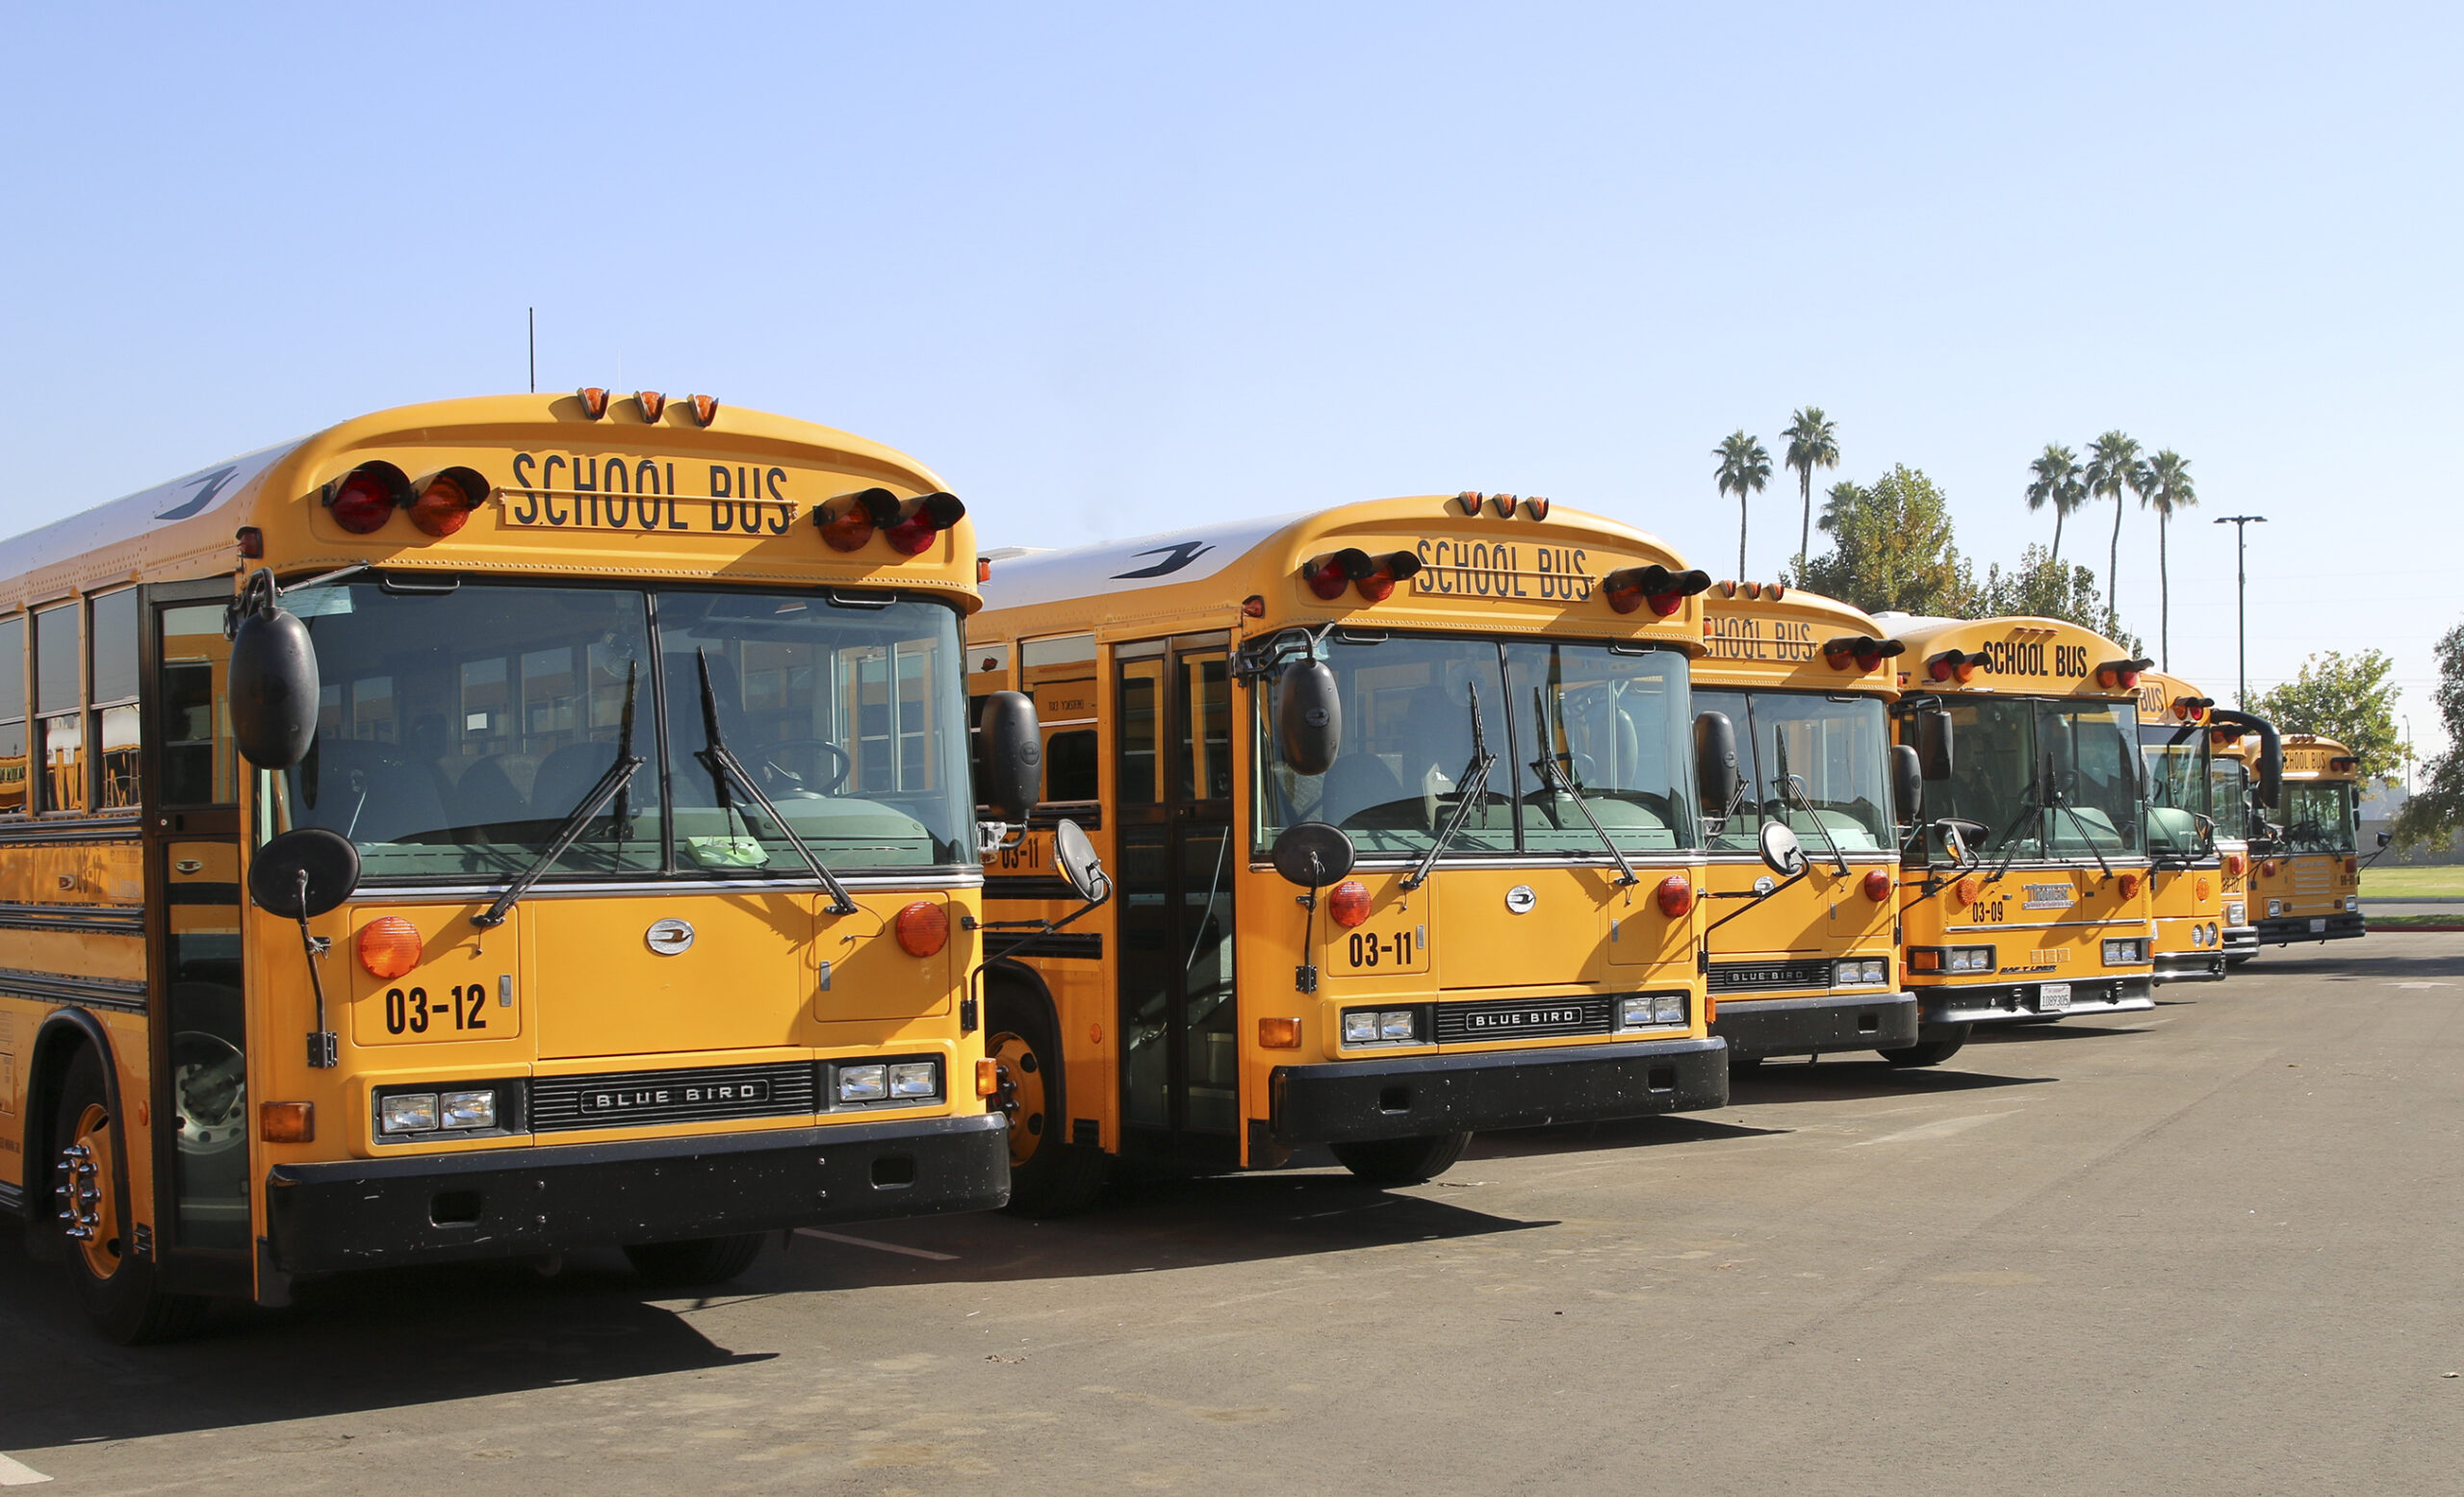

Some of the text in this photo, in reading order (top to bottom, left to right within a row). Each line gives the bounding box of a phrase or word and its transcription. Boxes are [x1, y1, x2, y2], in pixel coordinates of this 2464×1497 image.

[512, 452, 790, 535] SCHOOL BUS
[1417, 539, 1591, 601] SCHOOL BUS
[1775, 622, 1812, 661] BUS
[1983, 640, 2088, 679] SCHOOL BUS
[2311, 751, 2326, 769] BUS
[1972, 901, 2003, 922] 03-09
[1349, 932, 1411, 968] 03-11
[1732, 970, 1803, 981] BLUE BIRD
[386, 983, 486, 1035] 03-12
[1476, 1011, 1573, 1026] BLUE BIRD
[596, 1084, 755, 1108] BLUE BIRD
